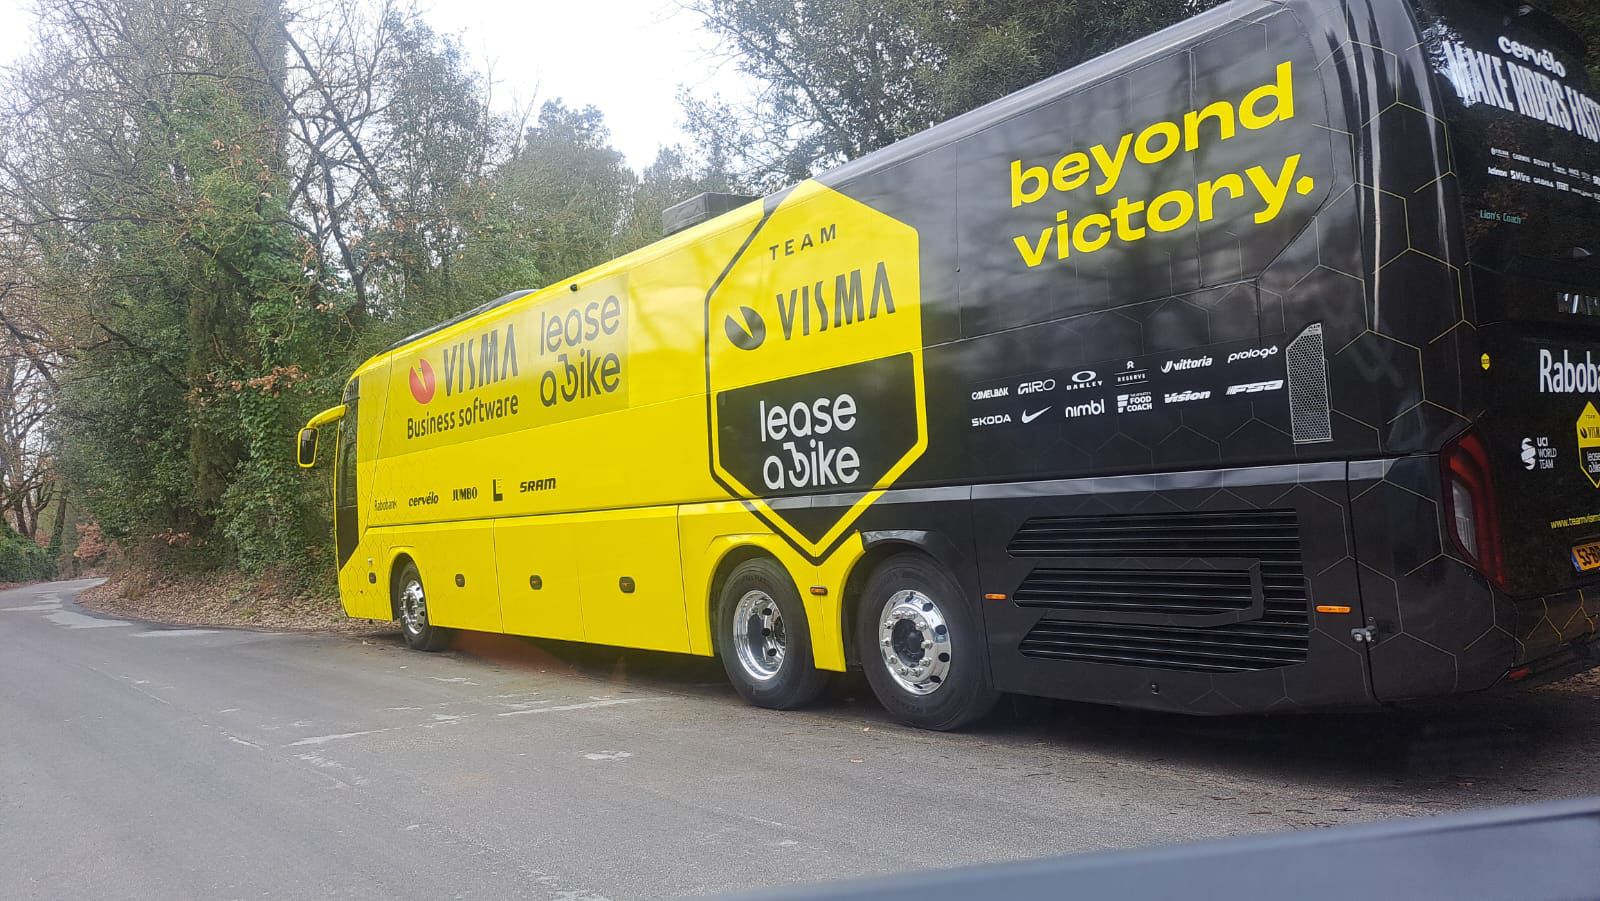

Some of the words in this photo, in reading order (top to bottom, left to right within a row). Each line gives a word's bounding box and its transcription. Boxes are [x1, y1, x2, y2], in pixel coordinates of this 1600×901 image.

[1506, 61, 1573, 131] RIDERS
[1010, 60, 1294, 209] beyond
[1013, 153, 1314, 268] victory.
[769, 223, 836, 261] TEAM
[775, 261, 896, 341] VISMA
[539, 295, 621, 356] lease
[443, 323, 519, 397] VISMA
[1227, 346, 1278, 363] prologo
[1173, 356, 1213, 372] vittoria
[1066, 381, 1103, 391] OAKLEY
[1117, 373, 1146, 383] RESERVE
[971, 386, 1009, 401] CAMELBAK
[1017, 378, 1056, 395] GIRO
[1064, 398, 1105, 418] nimbl
[1126, 402, 1153, 412] COACH
[1129, 395, 1152, 405] FOOD
[407, 411, 455, 439] Business
[458, 394, 519, 428] software
[759, 393, 857, 442] lease
[1536, 436, 1549, 447] UCI
[1538, 447, 1557, 458] WORLD
[1539, 459, 1554, 470] TEAM
[519, 477, 557, 493] SRAM
[408, 492, 439, 507] cervélo
[452, 486, 478, 502] JUMBO
